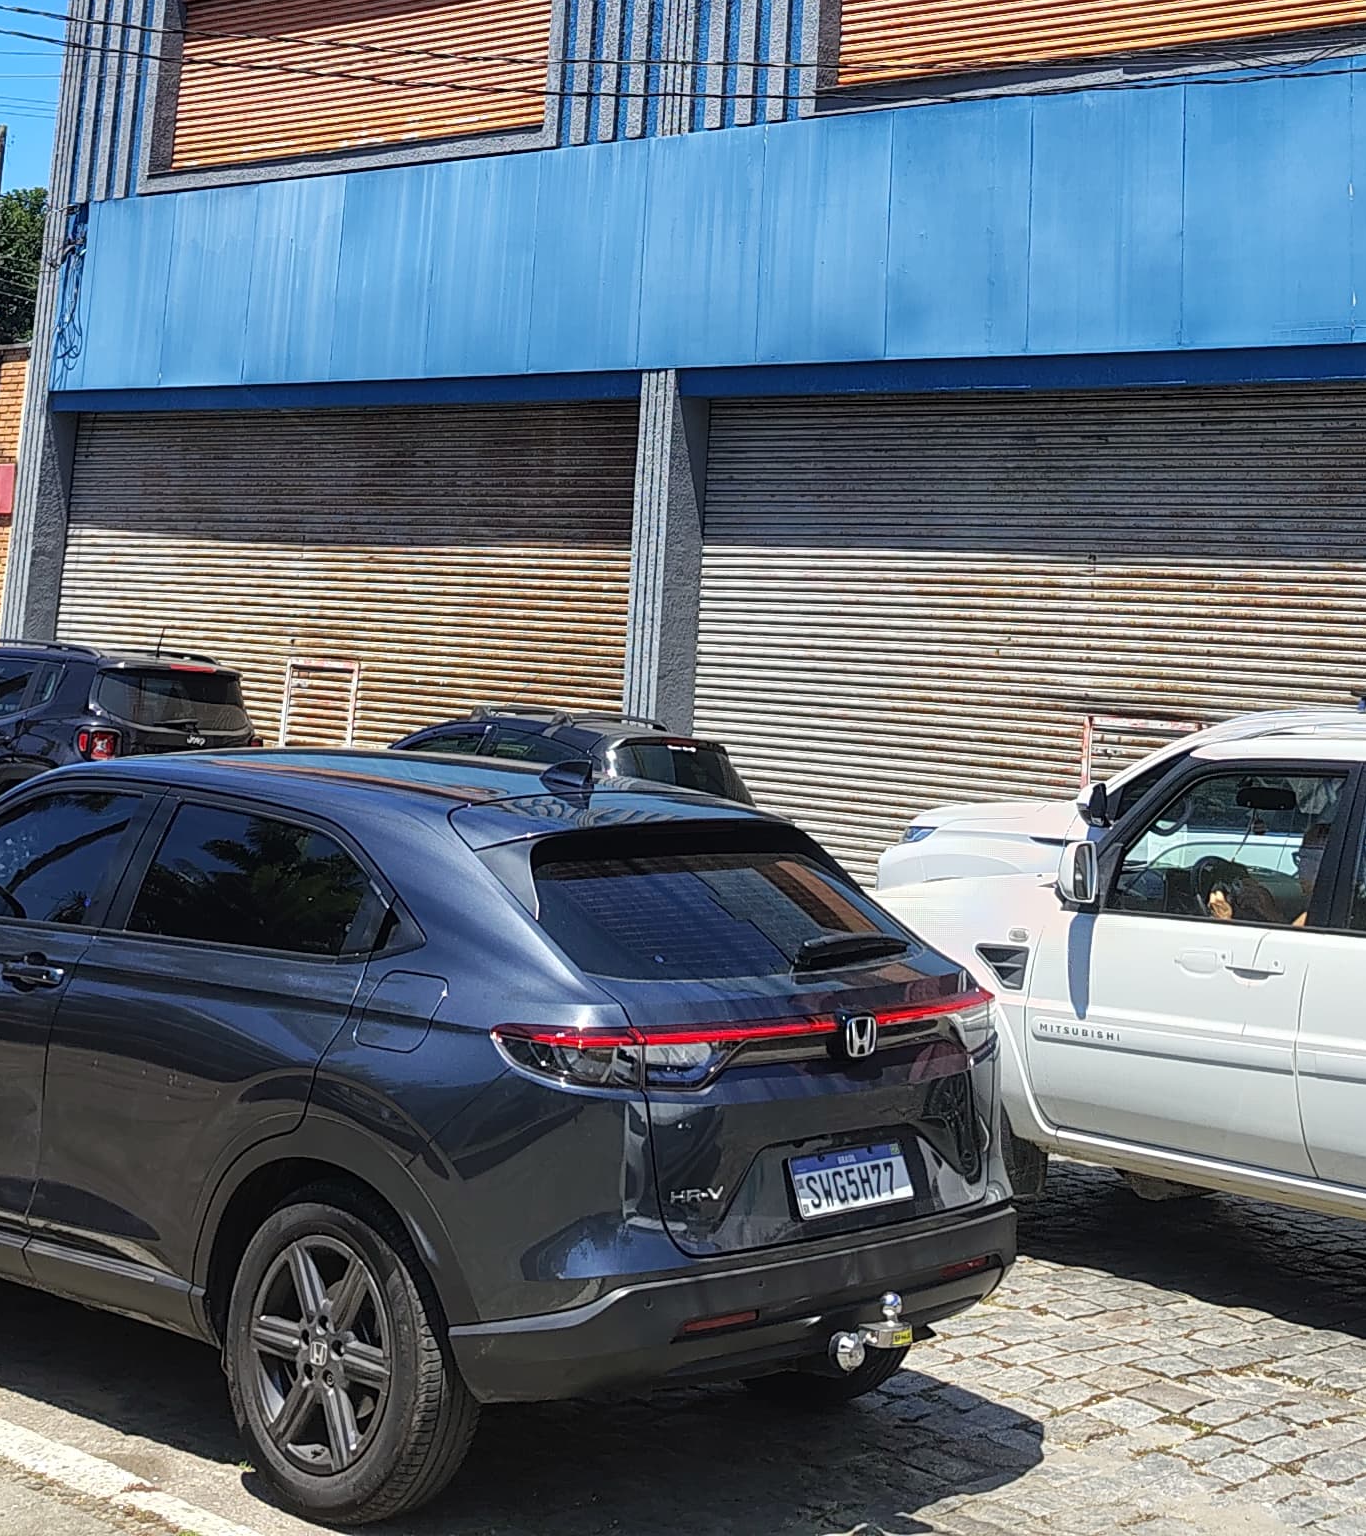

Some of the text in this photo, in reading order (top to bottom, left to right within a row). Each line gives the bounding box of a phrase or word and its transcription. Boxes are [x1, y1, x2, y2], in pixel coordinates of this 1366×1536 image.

[1039, 1022, 1121, 1042] MITSUBISHI
[670, 1185, 724, 1204] HR-V
[805, 1161, 895, 1209] SWG5H77
